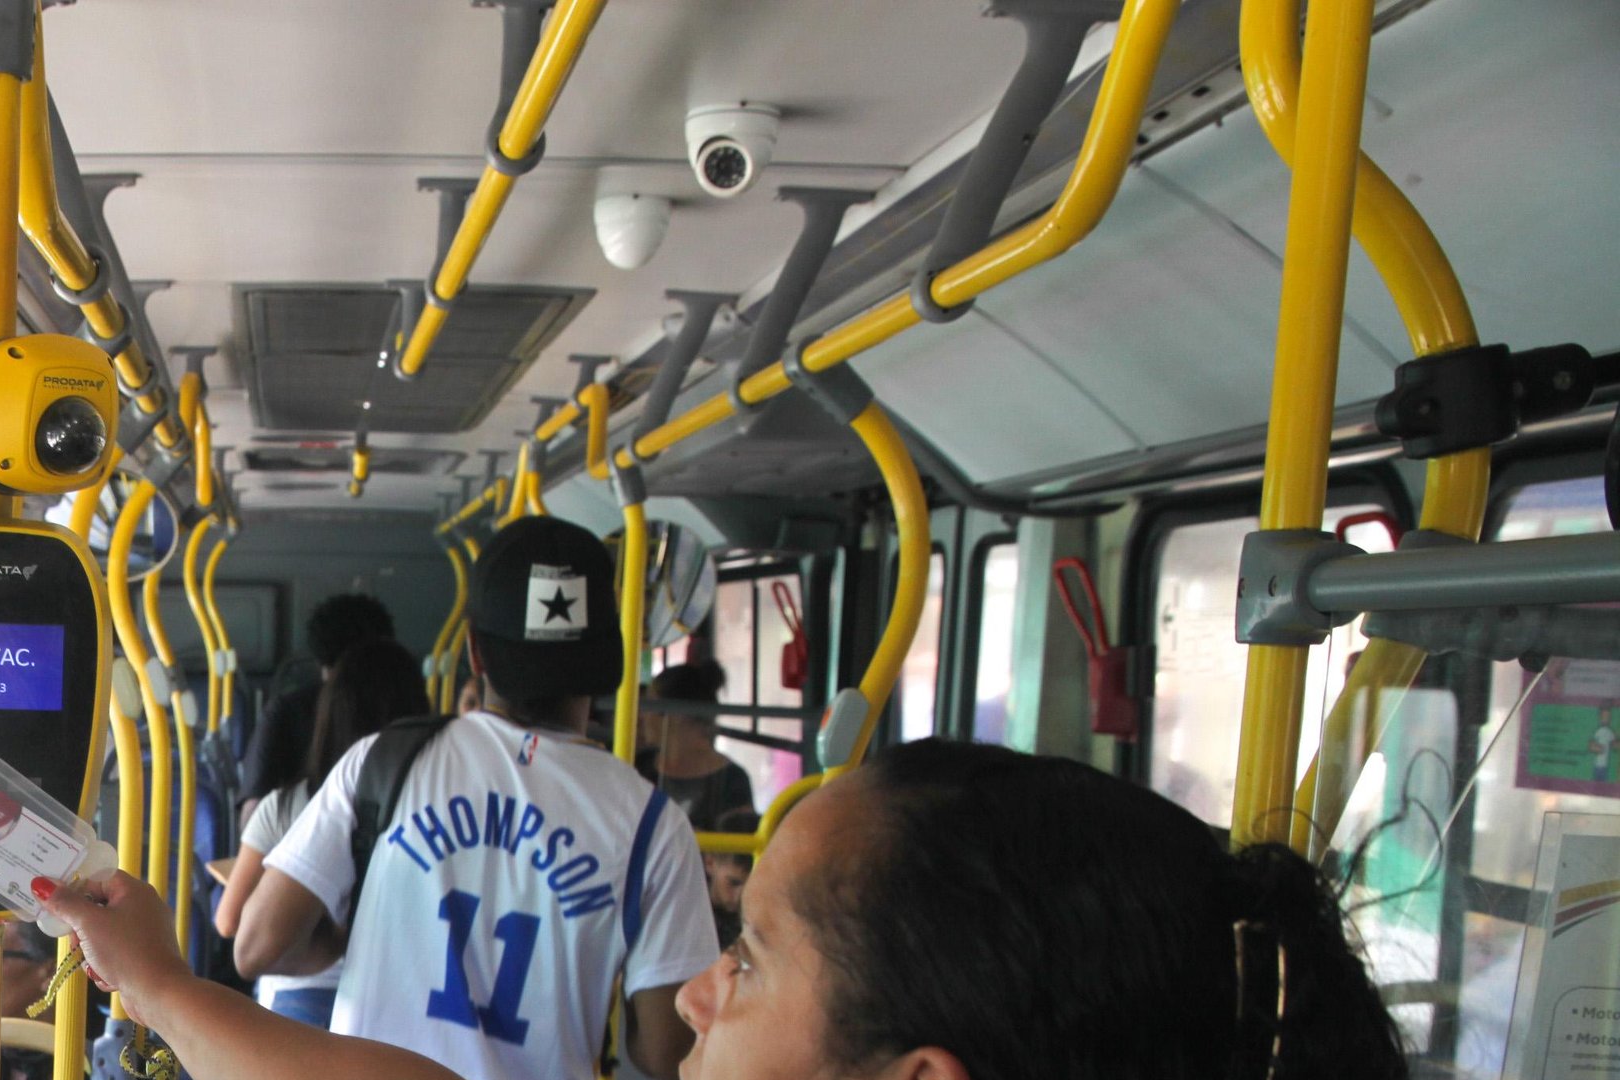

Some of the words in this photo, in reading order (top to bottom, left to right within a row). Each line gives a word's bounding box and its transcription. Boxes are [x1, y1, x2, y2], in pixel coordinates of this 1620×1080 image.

[43, 376, 95, 387] PRODATA
[387, 790, 616, 919] THOMPSON
[426, 888, 541, 1047] 11
